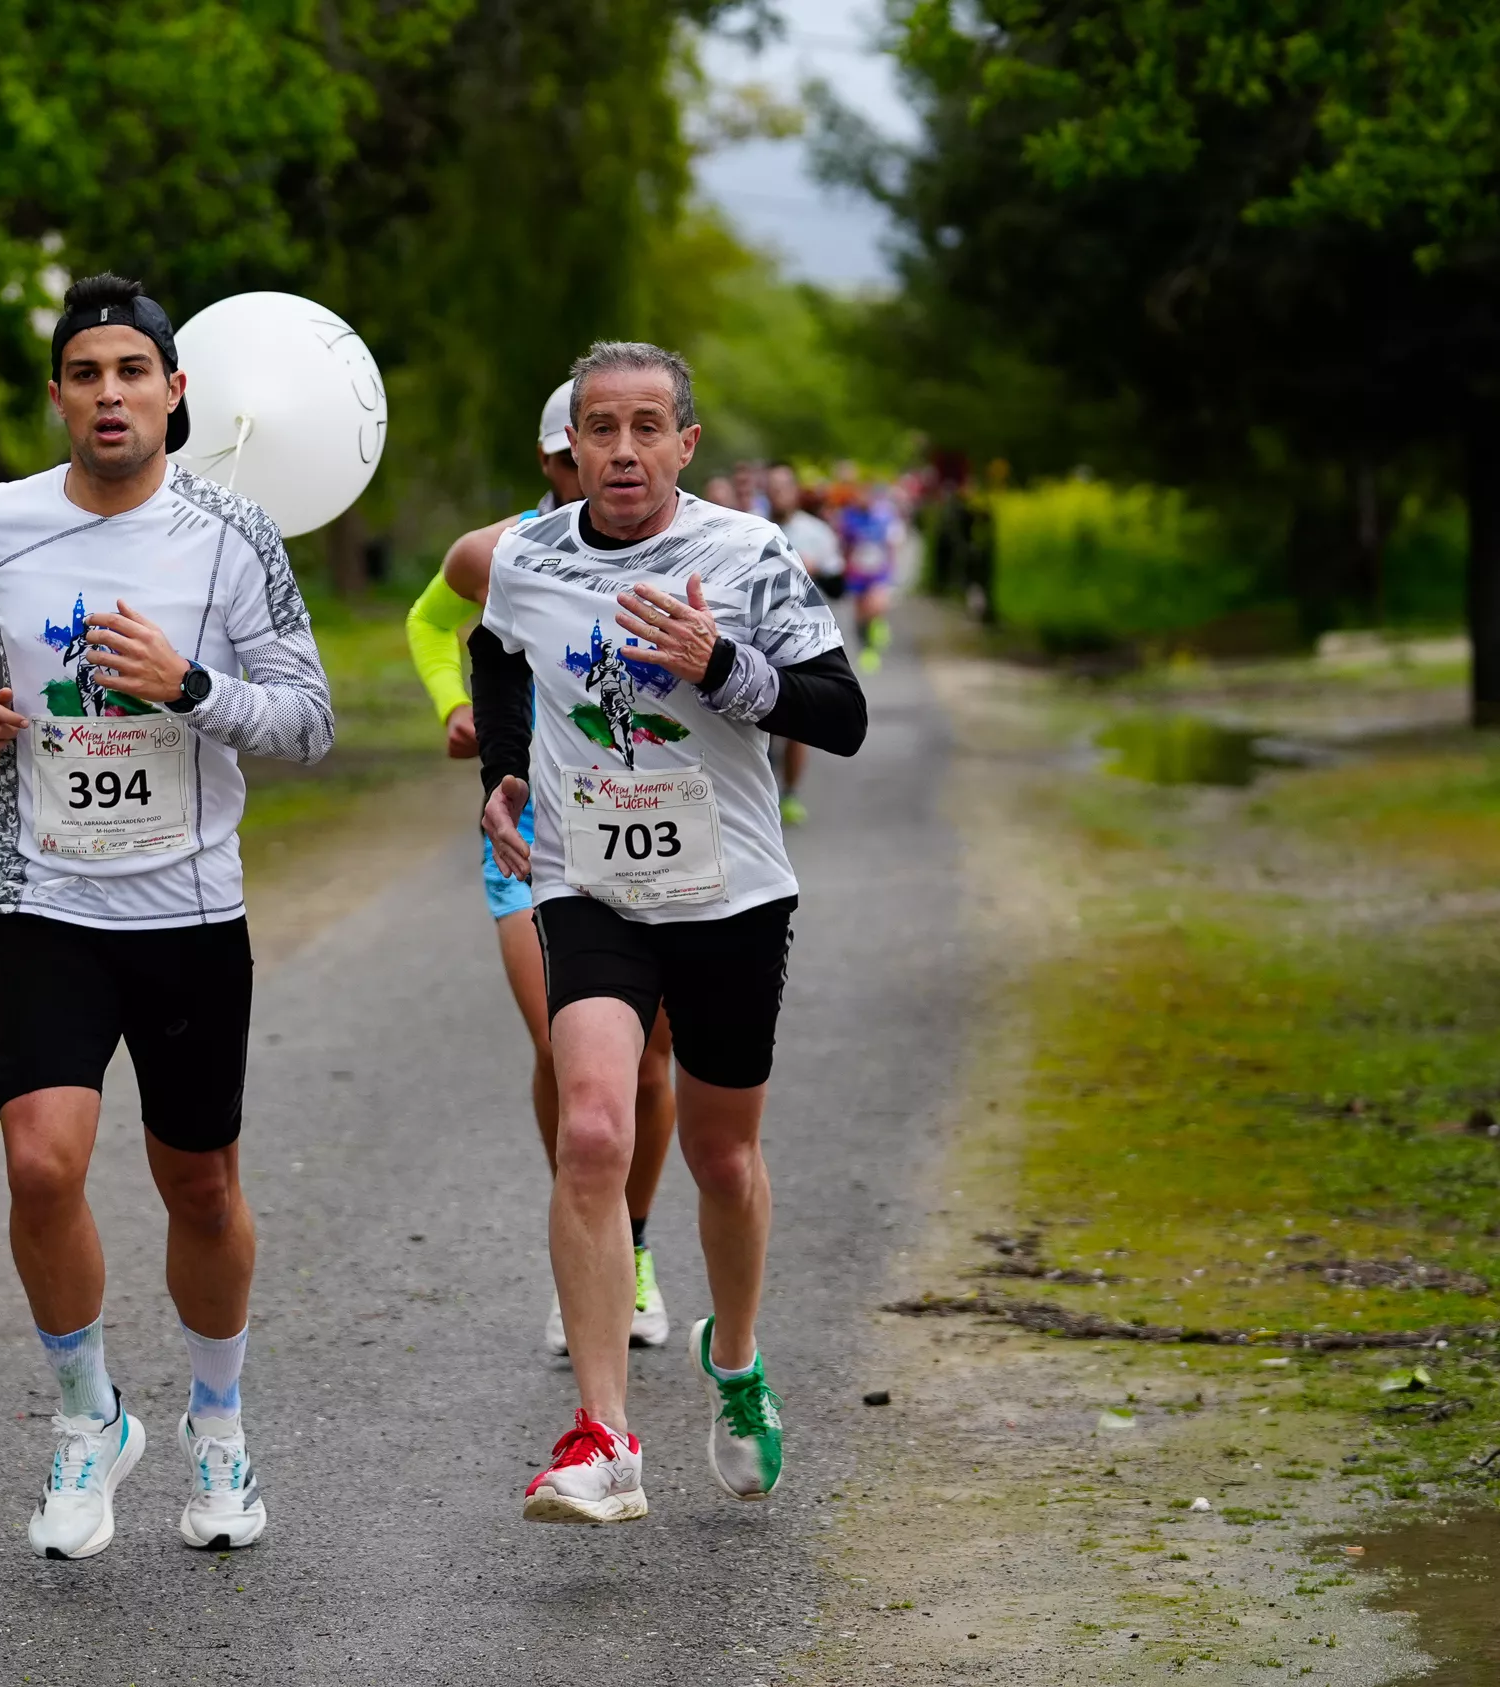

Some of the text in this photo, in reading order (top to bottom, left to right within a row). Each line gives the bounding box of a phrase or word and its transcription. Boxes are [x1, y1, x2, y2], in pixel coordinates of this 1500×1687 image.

[87, 742, 138, 757] LUCENA
[68, 769, 152, 809] 394
[615, 795, 666, 809] LUCENA
[598, 821, 681, 860] 703
